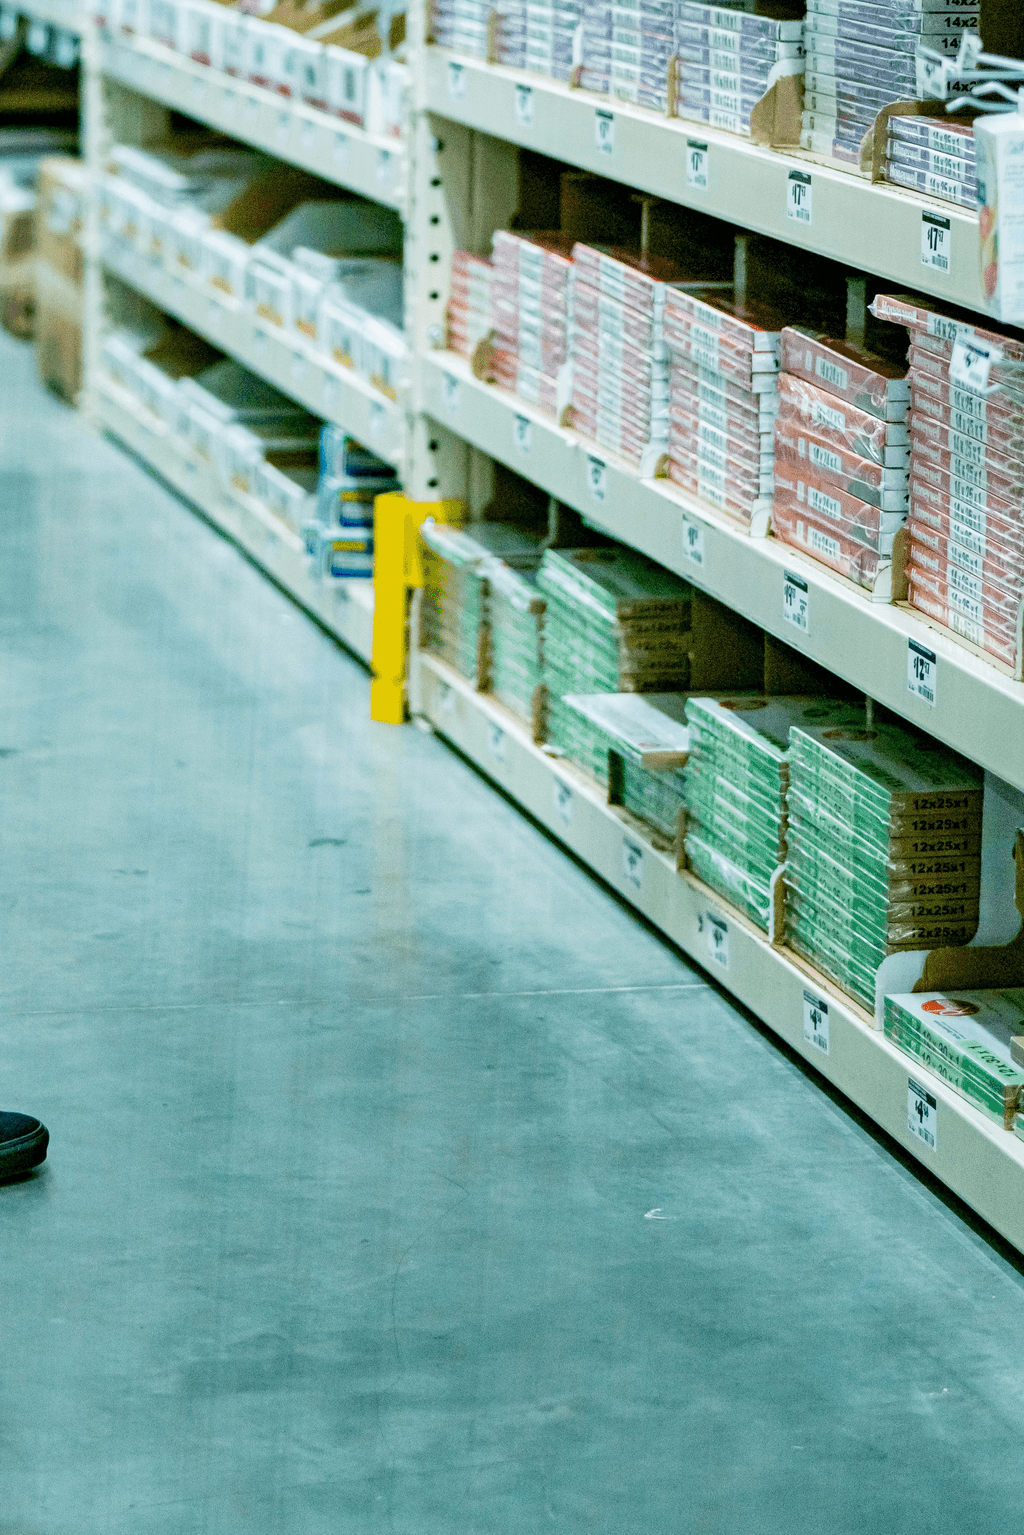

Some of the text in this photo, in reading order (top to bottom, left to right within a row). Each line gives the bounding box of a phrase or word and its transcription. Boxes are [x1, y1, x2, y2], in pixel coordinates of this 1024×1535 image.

[912, 798, 969, 810] 12x25x1
[912, 817, 968, 830] 12x25x1
[912, 840, 968, 852] 12x25x1
[910, 862, 966, 874] 12x25x1
[913, 883, 967, 895] 12x25x1
[911, 905, 965, 916] 12x25x1
[913, 926, 966, 938] 12x25x1
